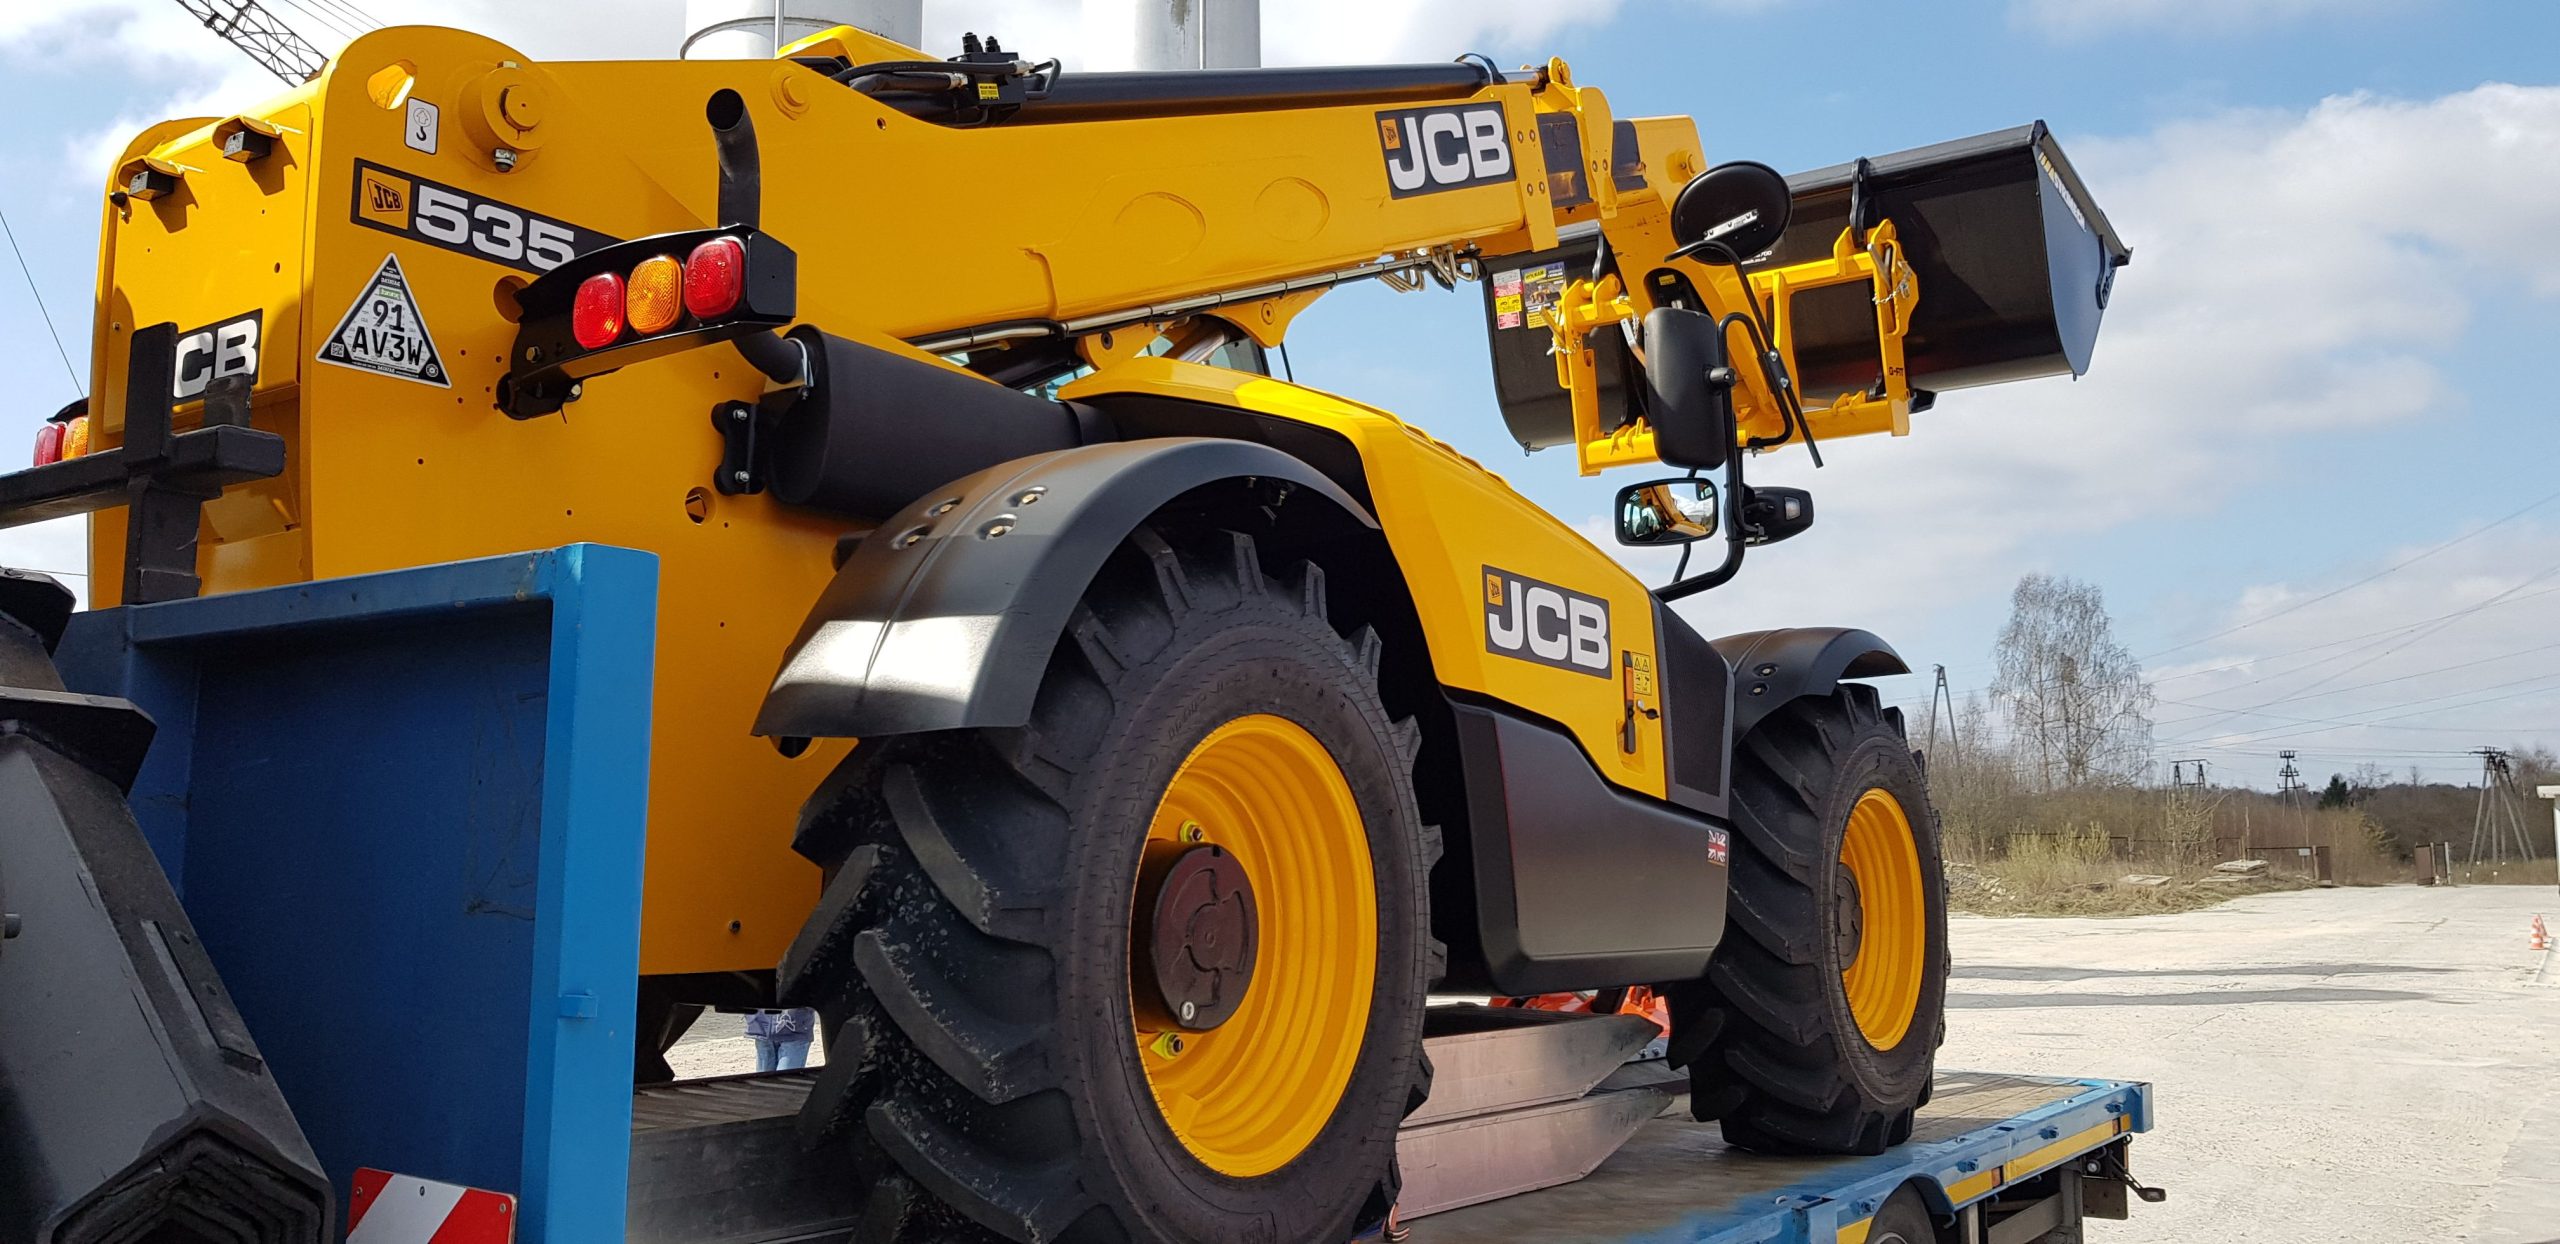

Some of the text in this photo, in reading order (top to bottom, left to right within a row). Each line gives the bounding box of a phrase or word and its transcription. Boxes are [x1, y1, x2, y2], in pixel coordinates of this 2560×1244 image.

[1388, 109, 1511, 190] JCB
[373, 183, 575, 270] JCB 535
[351, 326, 423, 366] AV3W
[373, 299, 405, 332] 91
[173, 318, 258, 398] CB
[1488, 580, 1609, 670] JCB
